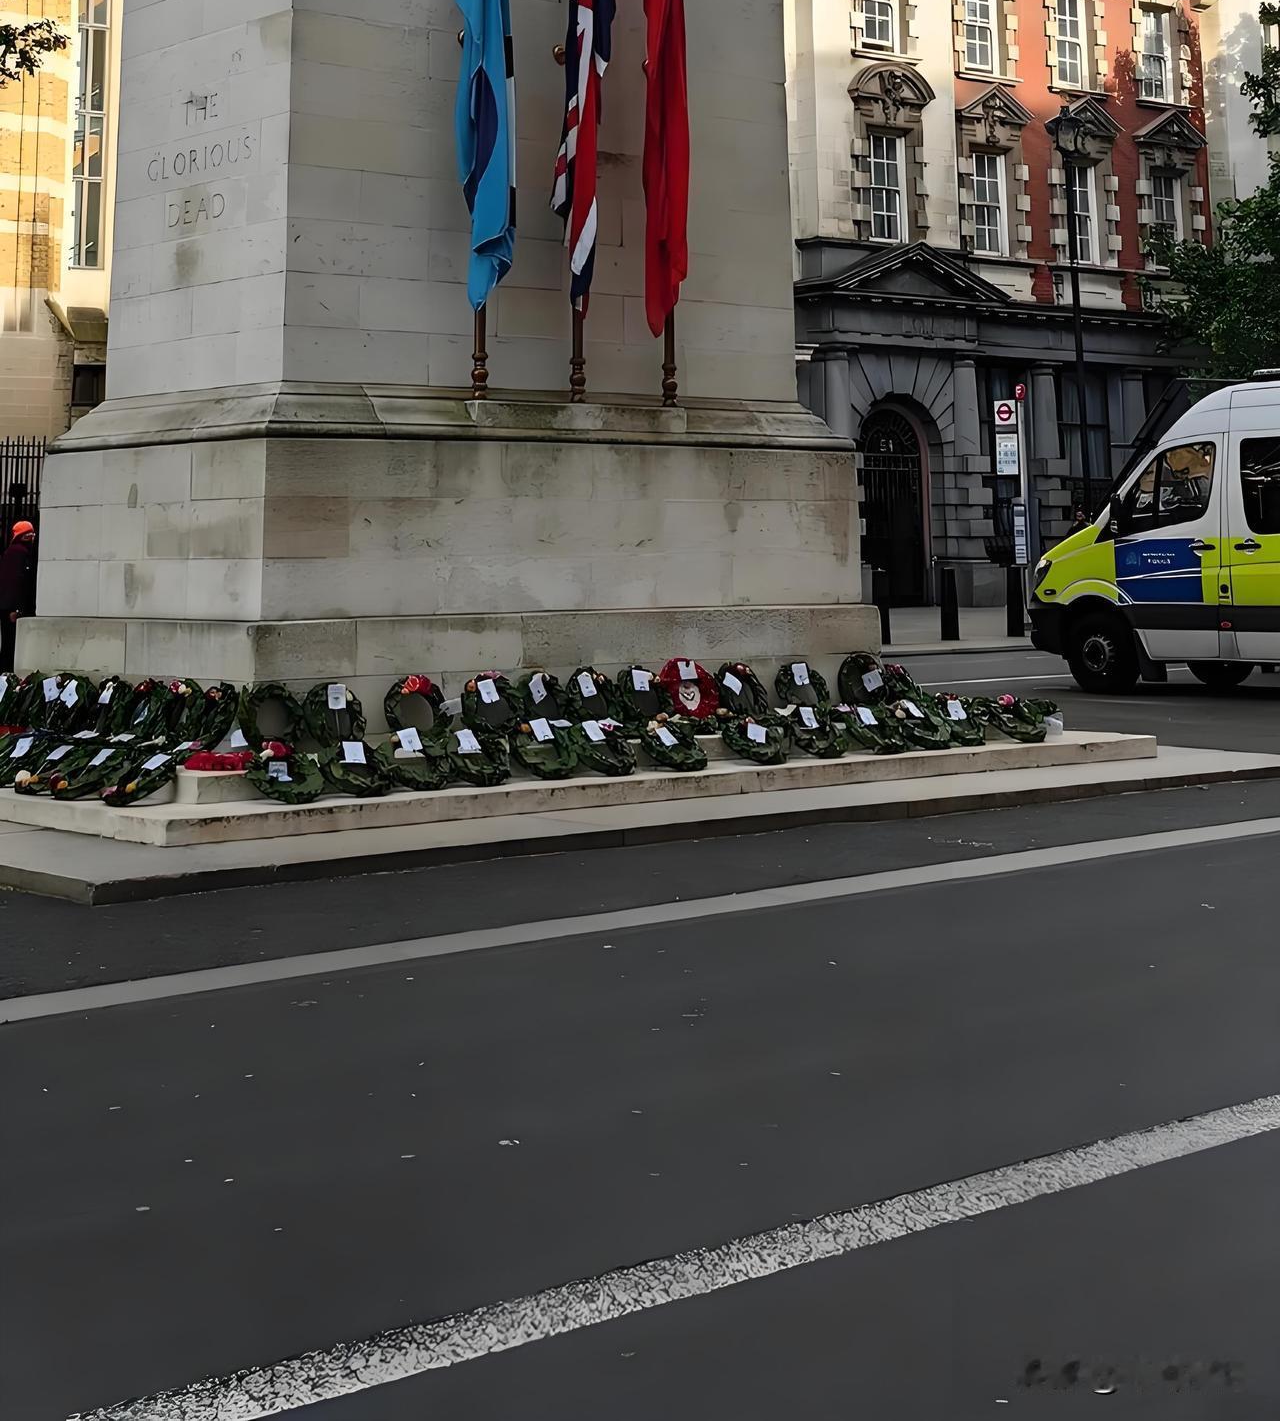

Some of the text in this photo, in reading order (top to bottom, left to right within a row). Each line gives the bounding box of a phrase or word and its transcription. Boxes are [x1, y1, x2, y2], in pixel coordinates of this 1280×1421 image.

[182, 92, 218, 126] THE
[147, 135, 252, 182] GLORIOUS
[168, 193, 226, 228] DEAD
